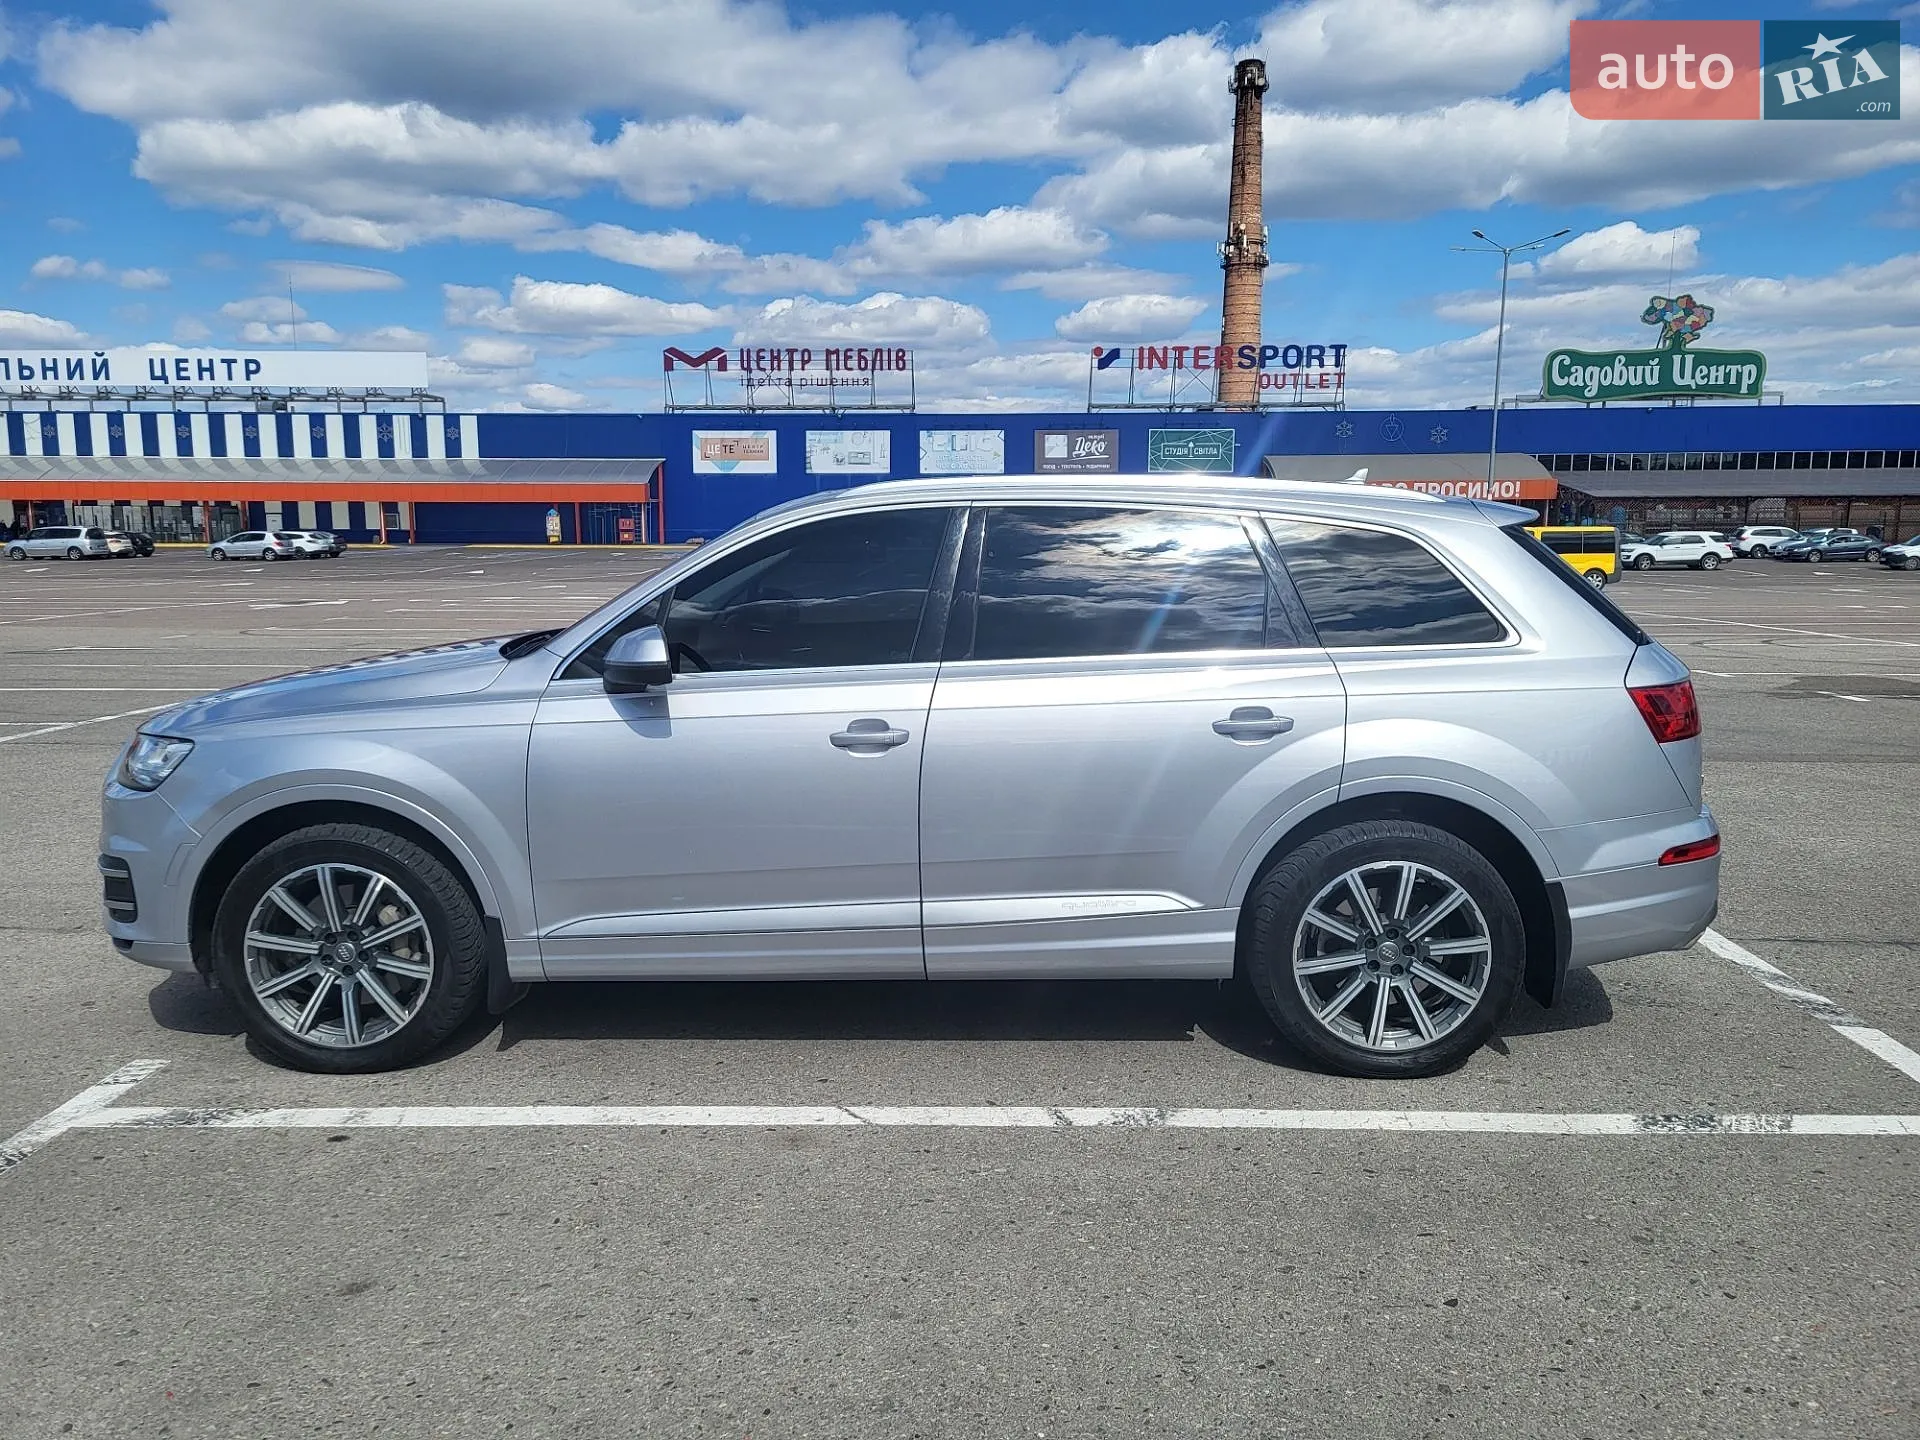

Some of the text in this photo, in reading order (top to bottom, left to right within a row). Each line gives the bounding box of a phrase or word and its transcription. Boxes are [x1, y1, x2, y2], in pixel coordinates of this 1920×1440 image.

[740, 348, 906, 373] ЦЕНТР МЕБЛІВ
[1138, 344, 1348, 371] INTERSPORT
[149, 358, 261, 384] ЦЕНТР
[1259, 373, 1346, 390] OUTLET
[1552, 354, 1757, 397] Садовий Центр
[800, 375, 871, 390] рішення
[1072, 436, 1106, 457] Деко
[1164, 447, 1218, 455] СТУДІЯ СВІТЛА
[1414, 481, 1521, 499] ПРОСИМО!
